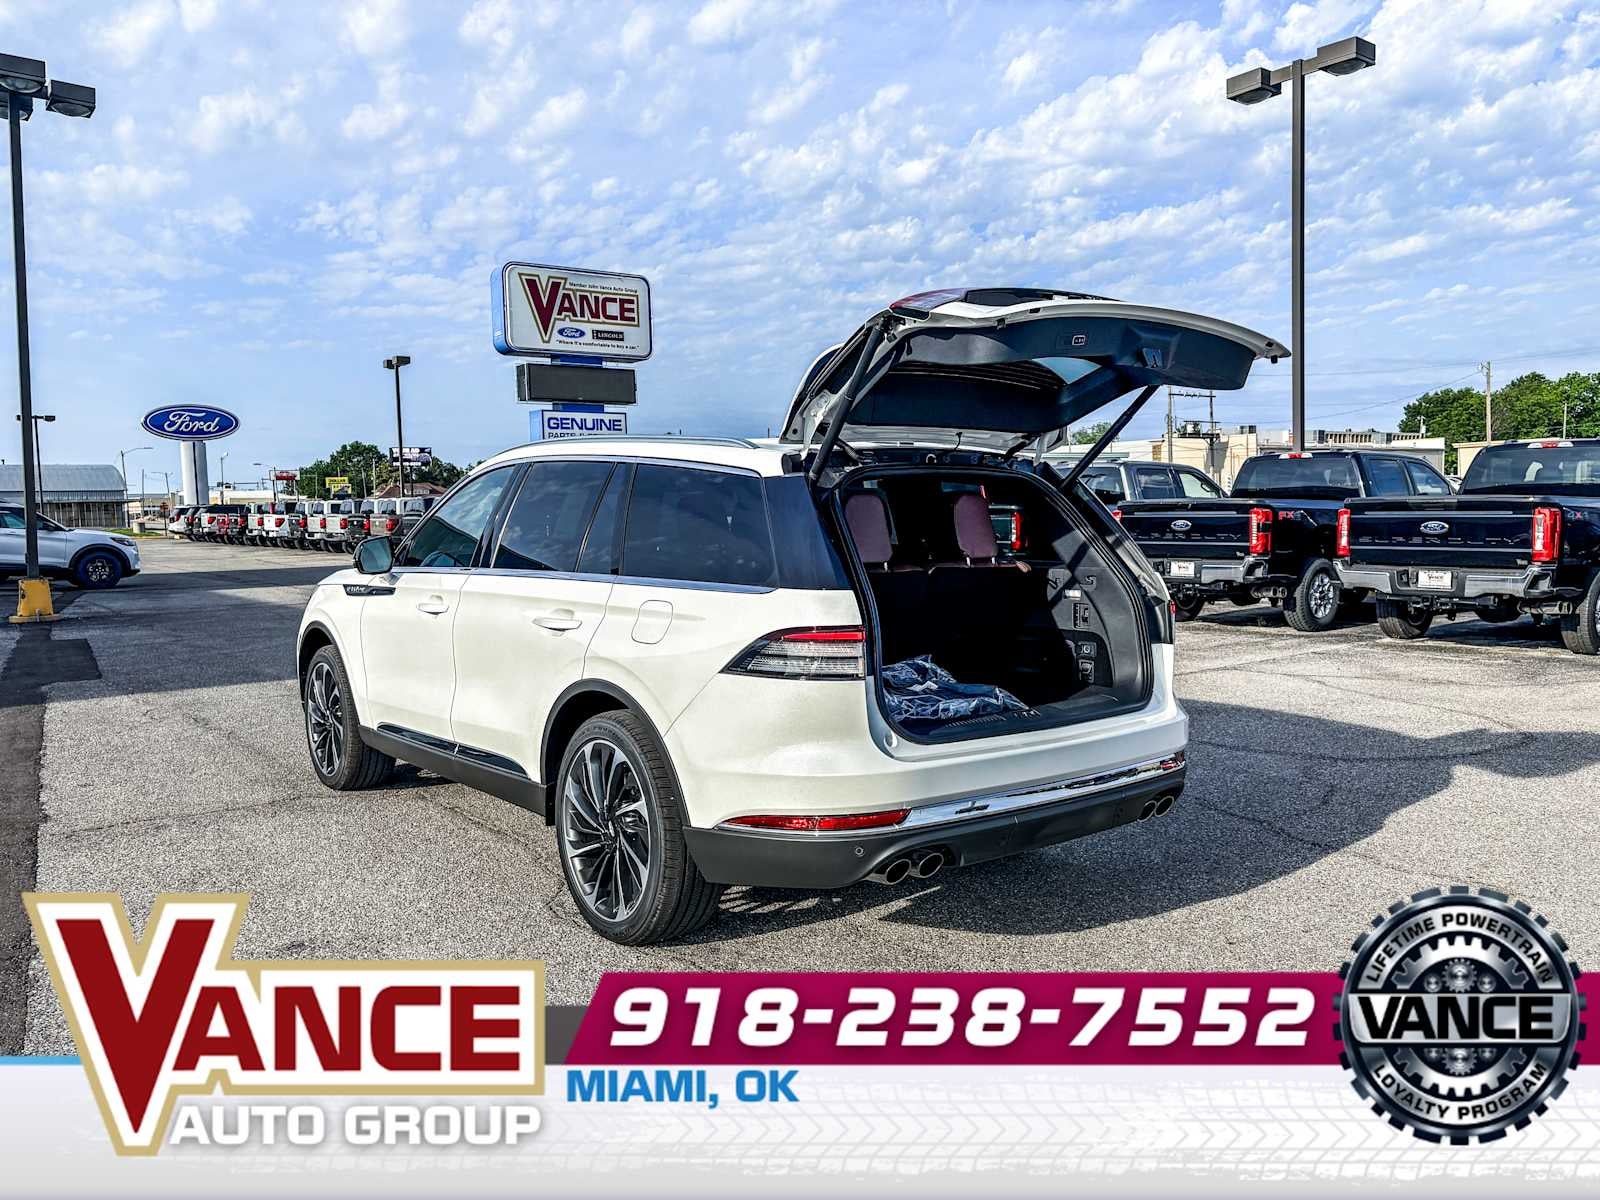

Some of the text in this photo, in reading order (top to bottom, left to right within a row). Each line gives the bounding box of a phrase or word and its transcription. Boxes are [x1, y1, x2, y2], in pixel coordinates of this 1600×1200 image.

[524, 278, 636, 337] VANCE
[562, 328, 581, 337] Ford
[163, 411, 220, 432] Ford
[547, 417, 622, 432] GENUINE
